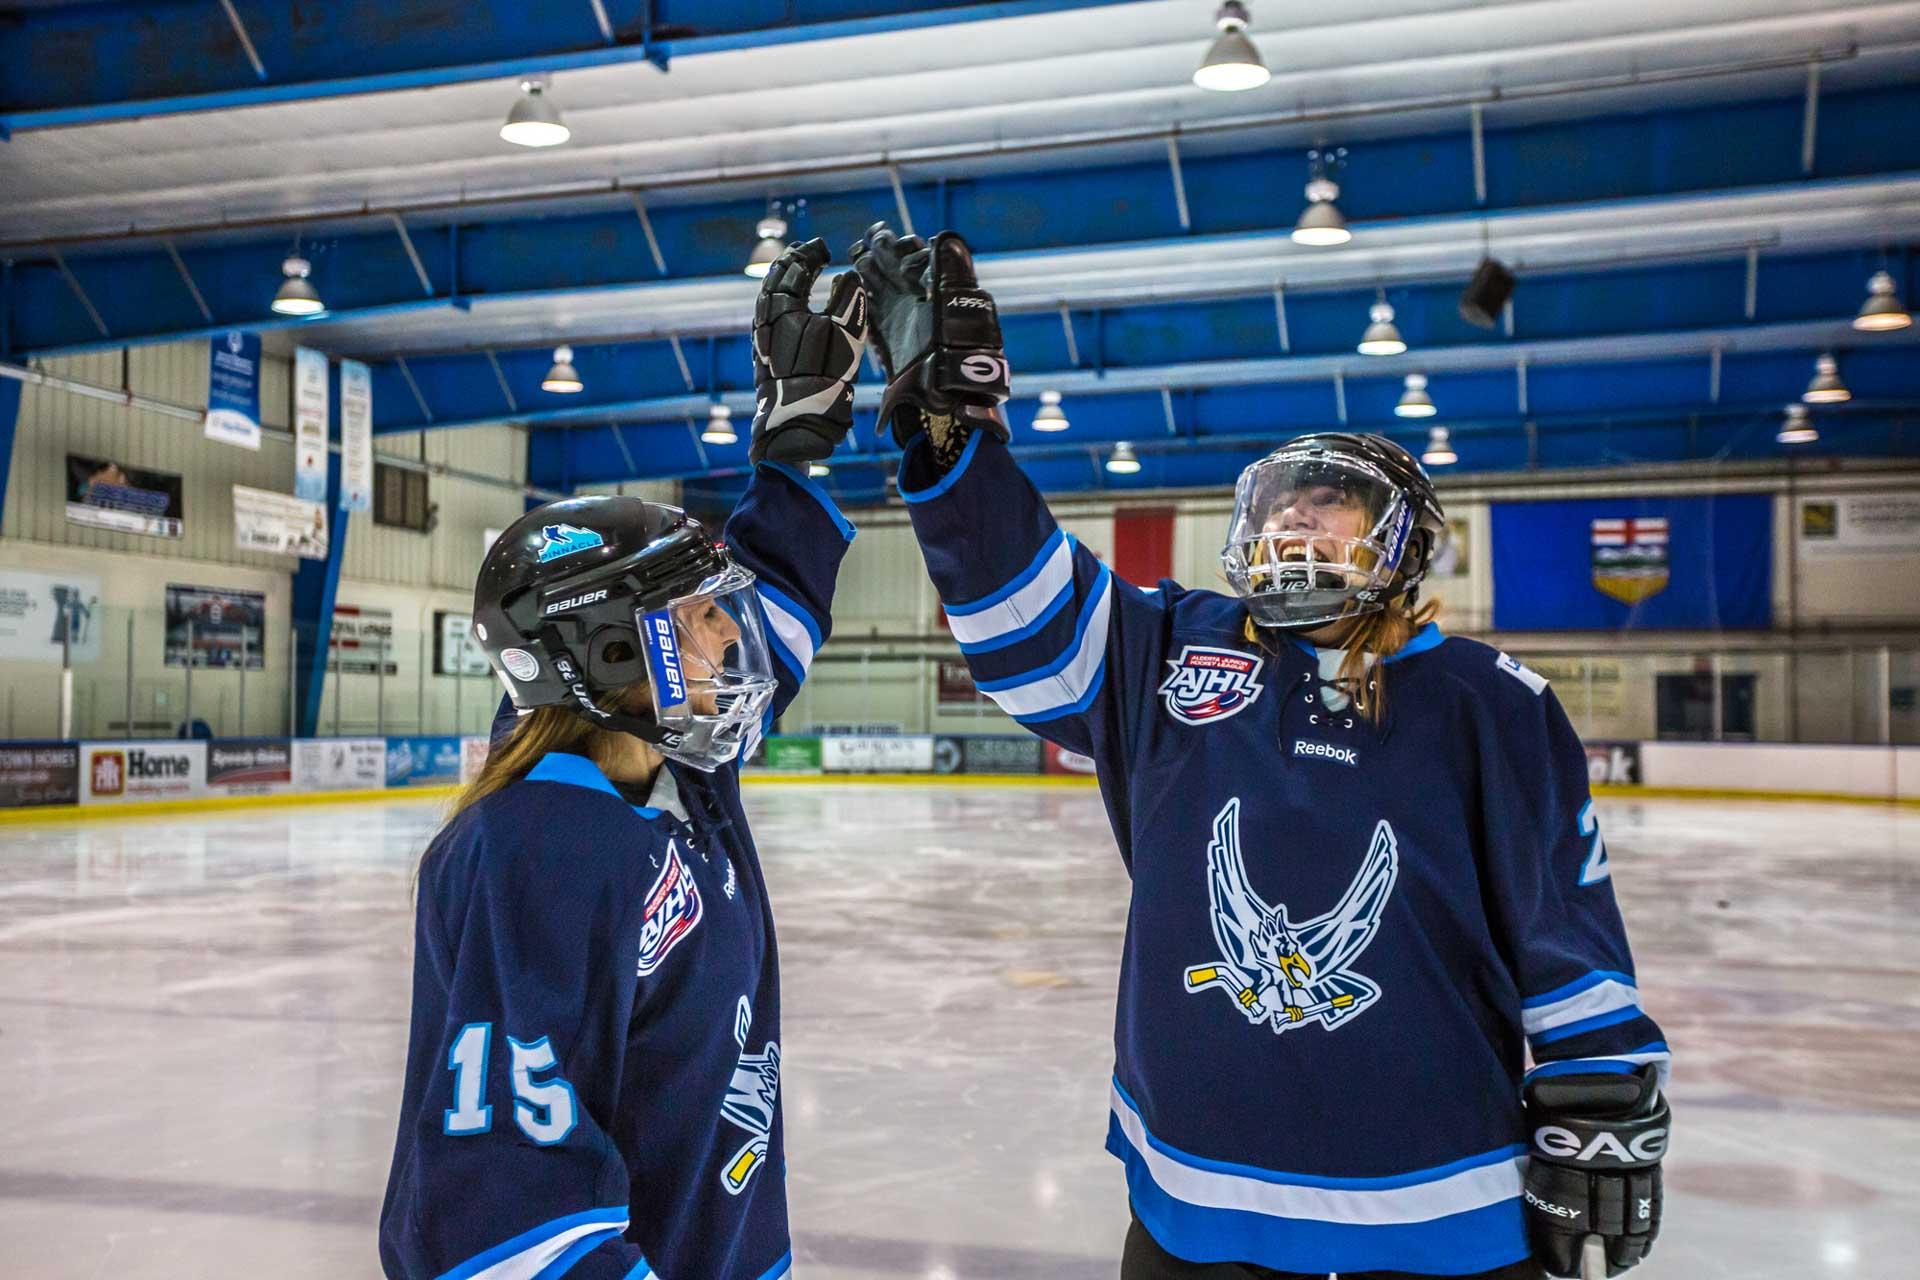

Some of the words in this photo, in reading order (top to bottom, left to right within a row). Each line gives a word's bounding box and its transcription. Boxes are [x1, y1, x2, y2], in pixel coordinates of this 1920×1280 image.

[546, 589, 608, 615] BAUER
[655, 618, 684, 699] BAUER
[1168, 666, 1253, 699] AJHL
[127, 749, 190, 778] Home
[1294, 740, 1358, 766] Reebok
[444, 1021, 578, 1146] 15
